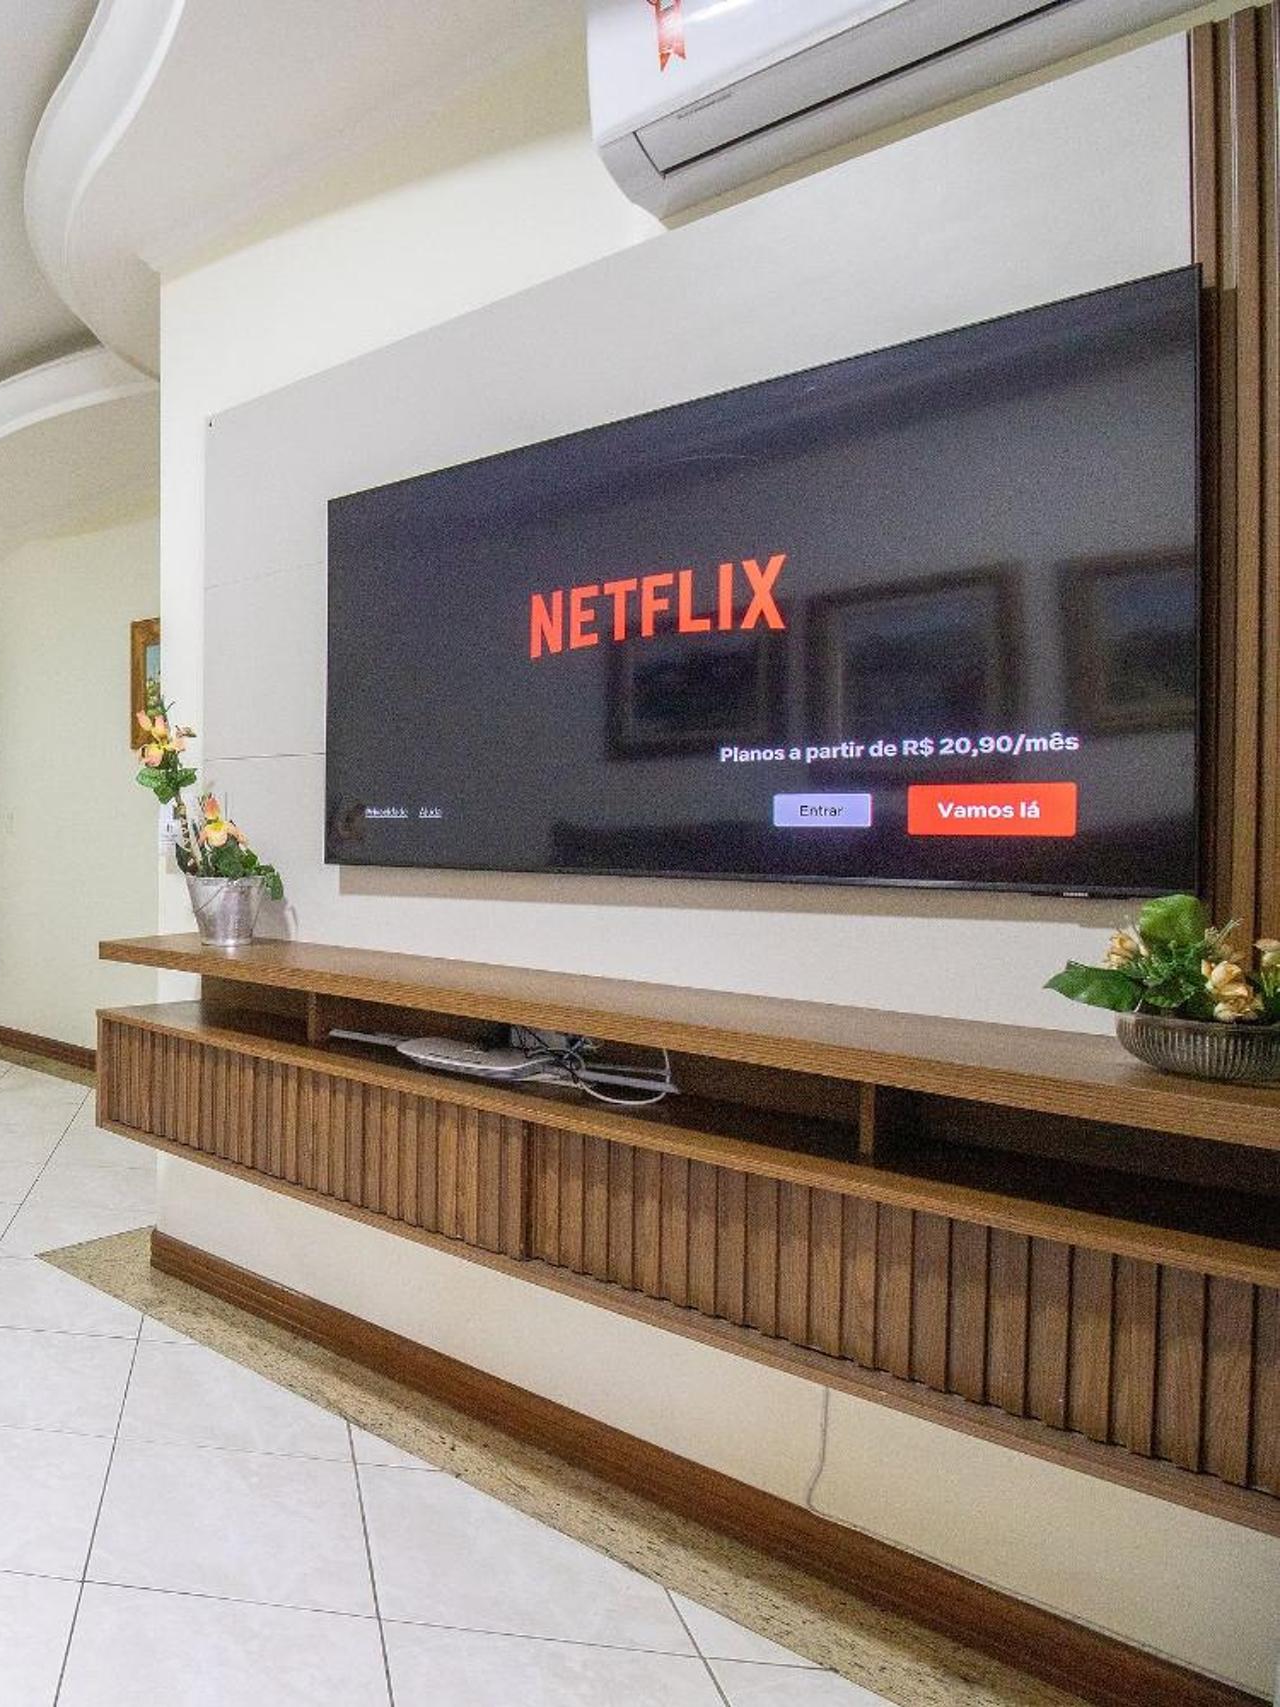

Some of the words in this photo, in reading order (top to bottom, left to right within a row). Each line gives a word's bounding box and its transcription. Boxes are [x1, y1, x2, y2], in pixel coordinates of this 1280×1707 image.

[530, 554, 786, 659] NETFLIX
[720, 746, 785, 763] Planos
[789, 748, 801, 760] a
[806, 741, 864, 763] partir
[869, 740, 897, 757] de
[902, 737, 934, 757] R$
[939, 732, 1080, 757] 20,90/mês
[800, 805, 843, 817] Entrar
[937, 802, 1015, 819] Vamos
[1020, 801, 1040, 819] lá
